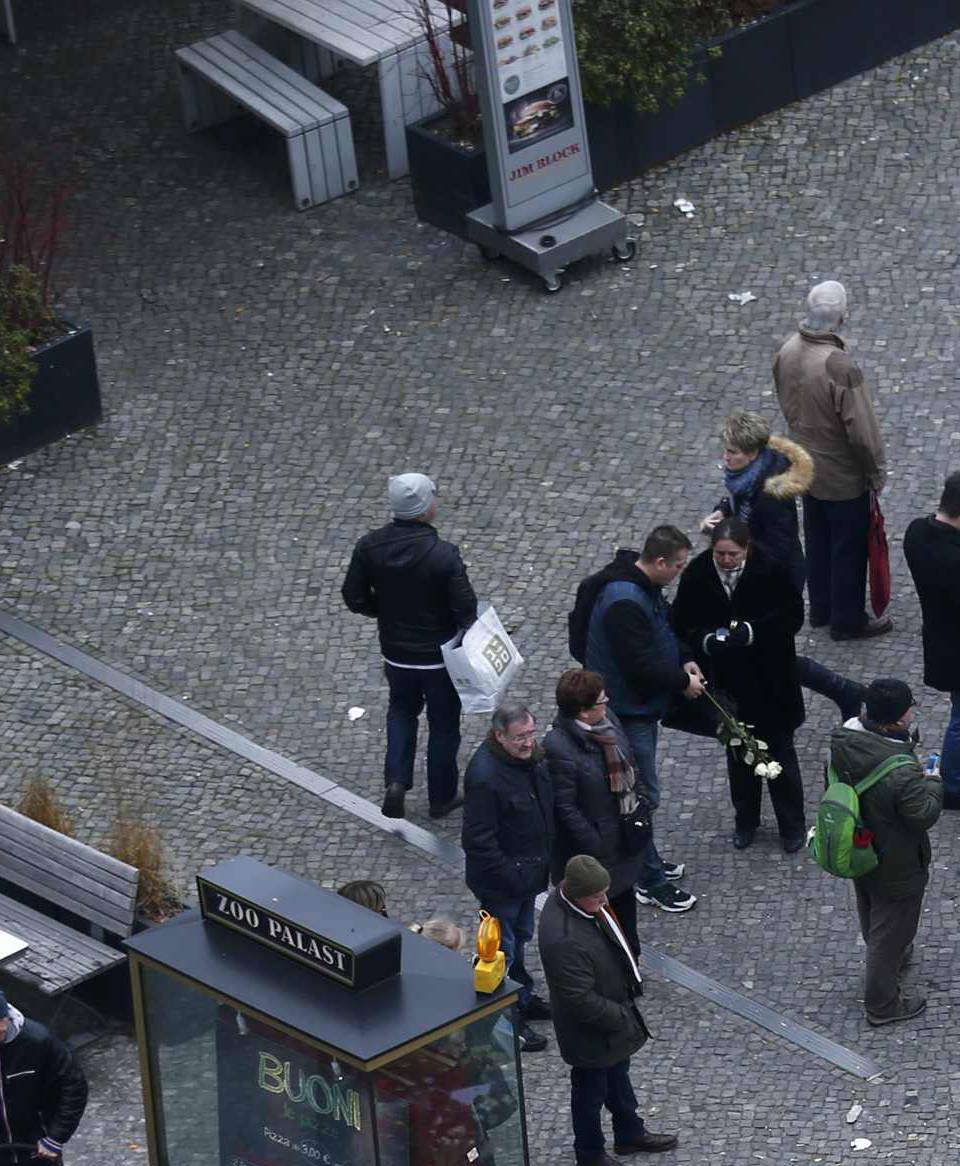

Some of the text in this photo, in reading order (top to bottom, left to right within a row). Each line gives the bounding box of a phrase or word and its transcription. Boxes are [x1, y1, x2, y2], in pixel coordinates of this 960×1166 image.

[510, 143, 580, 182] JIM BLOCK
[216, 893, 346, 971] ZOO PALAST
[258, 1051, 361, 1132] BUONI
[263, 1126, 290, 1148] Pizza
